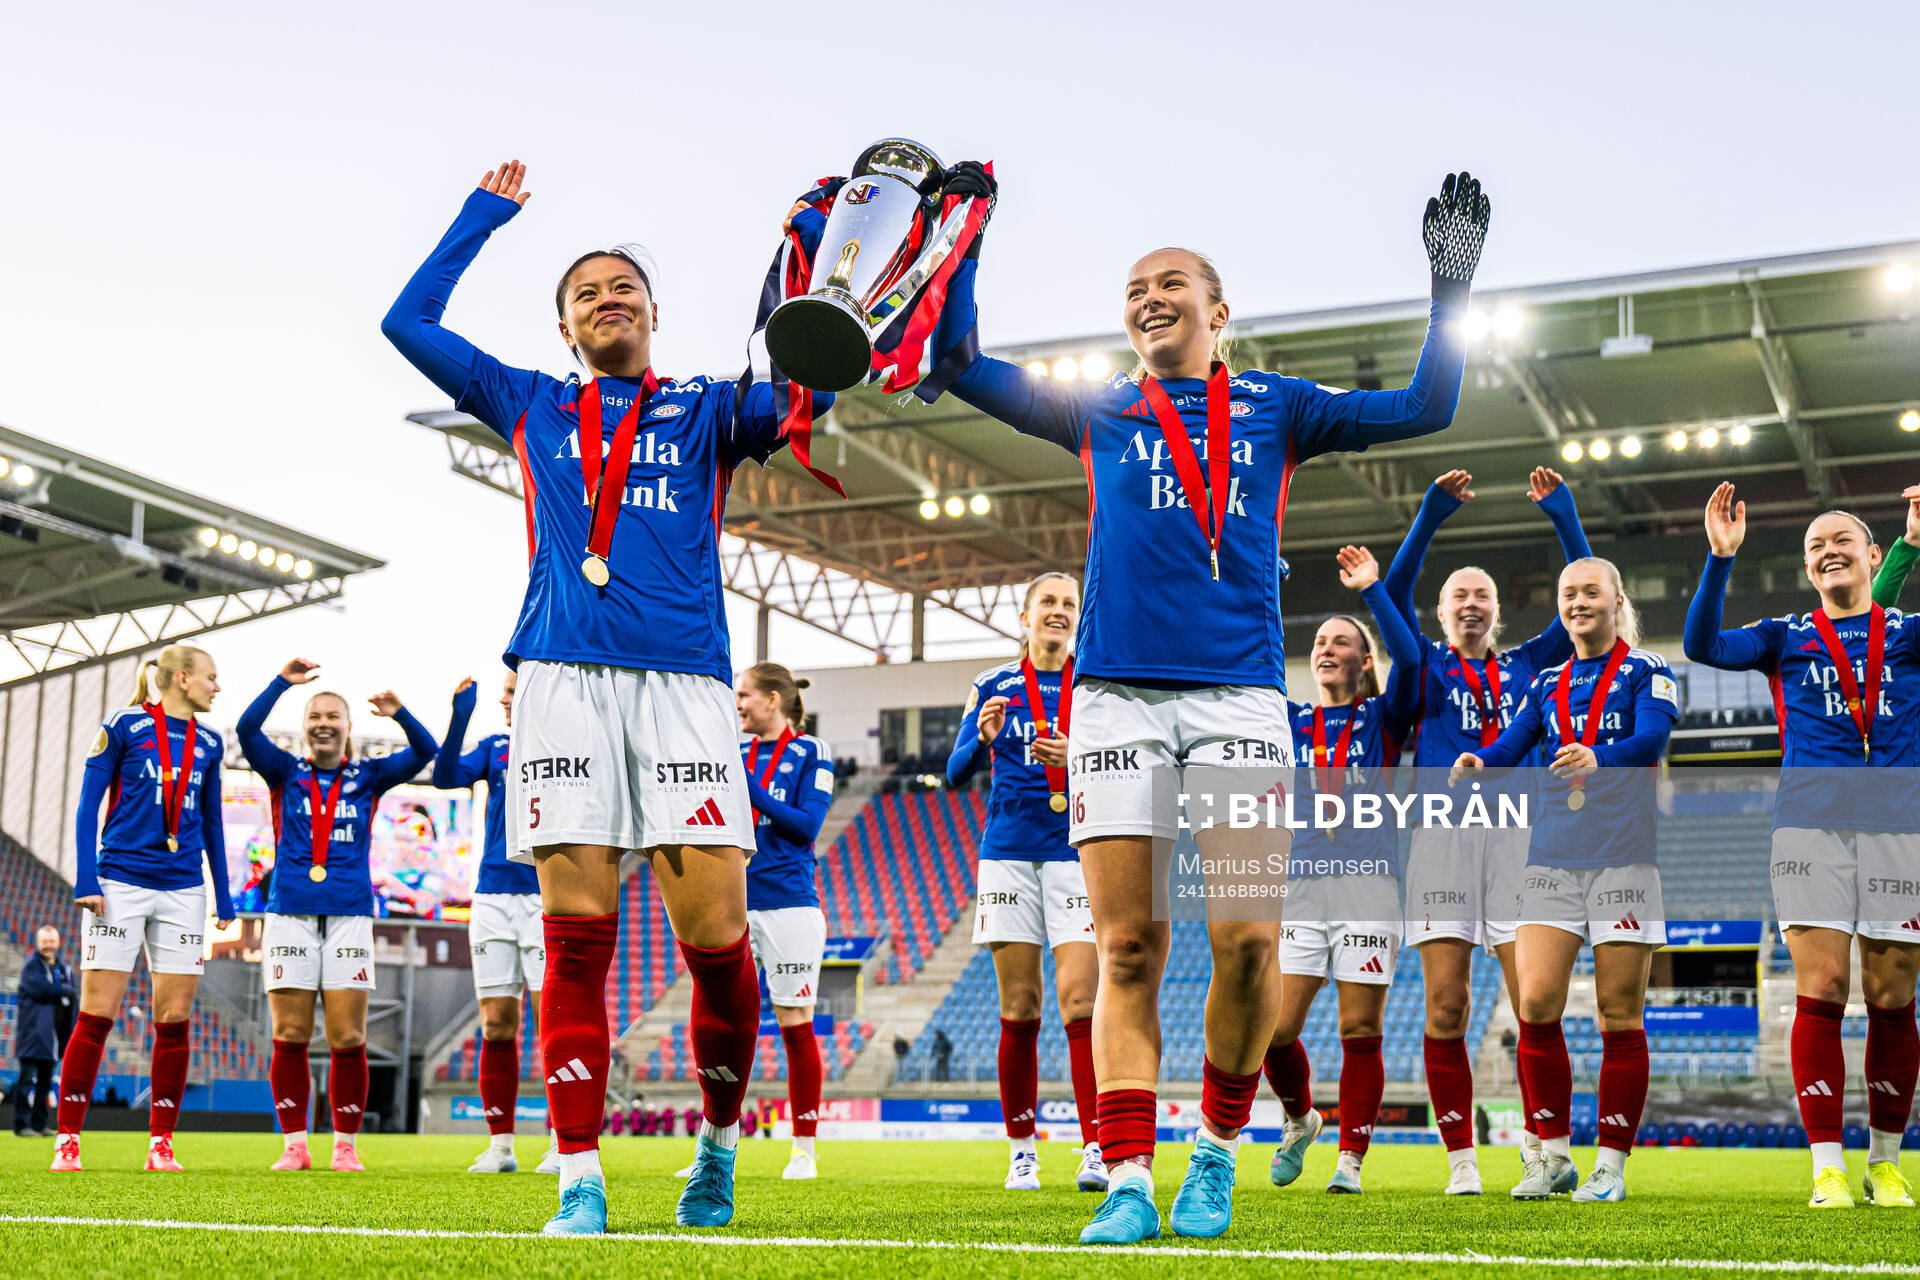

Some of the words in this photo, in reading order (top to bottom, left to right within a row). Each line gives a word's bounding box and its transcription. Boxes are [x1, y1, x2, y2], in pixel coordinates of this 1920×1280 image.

[1118, 428, 1254, 471] Apria
[1149, 474, 1248, 518] Bak
[1072, 749, 1140, 776] STERK
[1222, 739, 1290, 769] STERK
[521, 757, 591, 784] STERK
[657, 762, 729, 784] STERK
[529, 797, 541, 829] 5
[1071, 791, 1086, 825] 16
[1771, 861, 1812, 879] STERK
[980, 892, 1019, 906] STERK
[1423, 890, 1466, 906] STERK
[1597, 889, 1646, 906] STERK
[89, 925, 127, 939] STERK
[1343, 934, 1387, 949] STERK
[270, 946, 307, 957] STERK
[273, 964, 283, 980] 10
[777, 962, 813, 975] STERK
